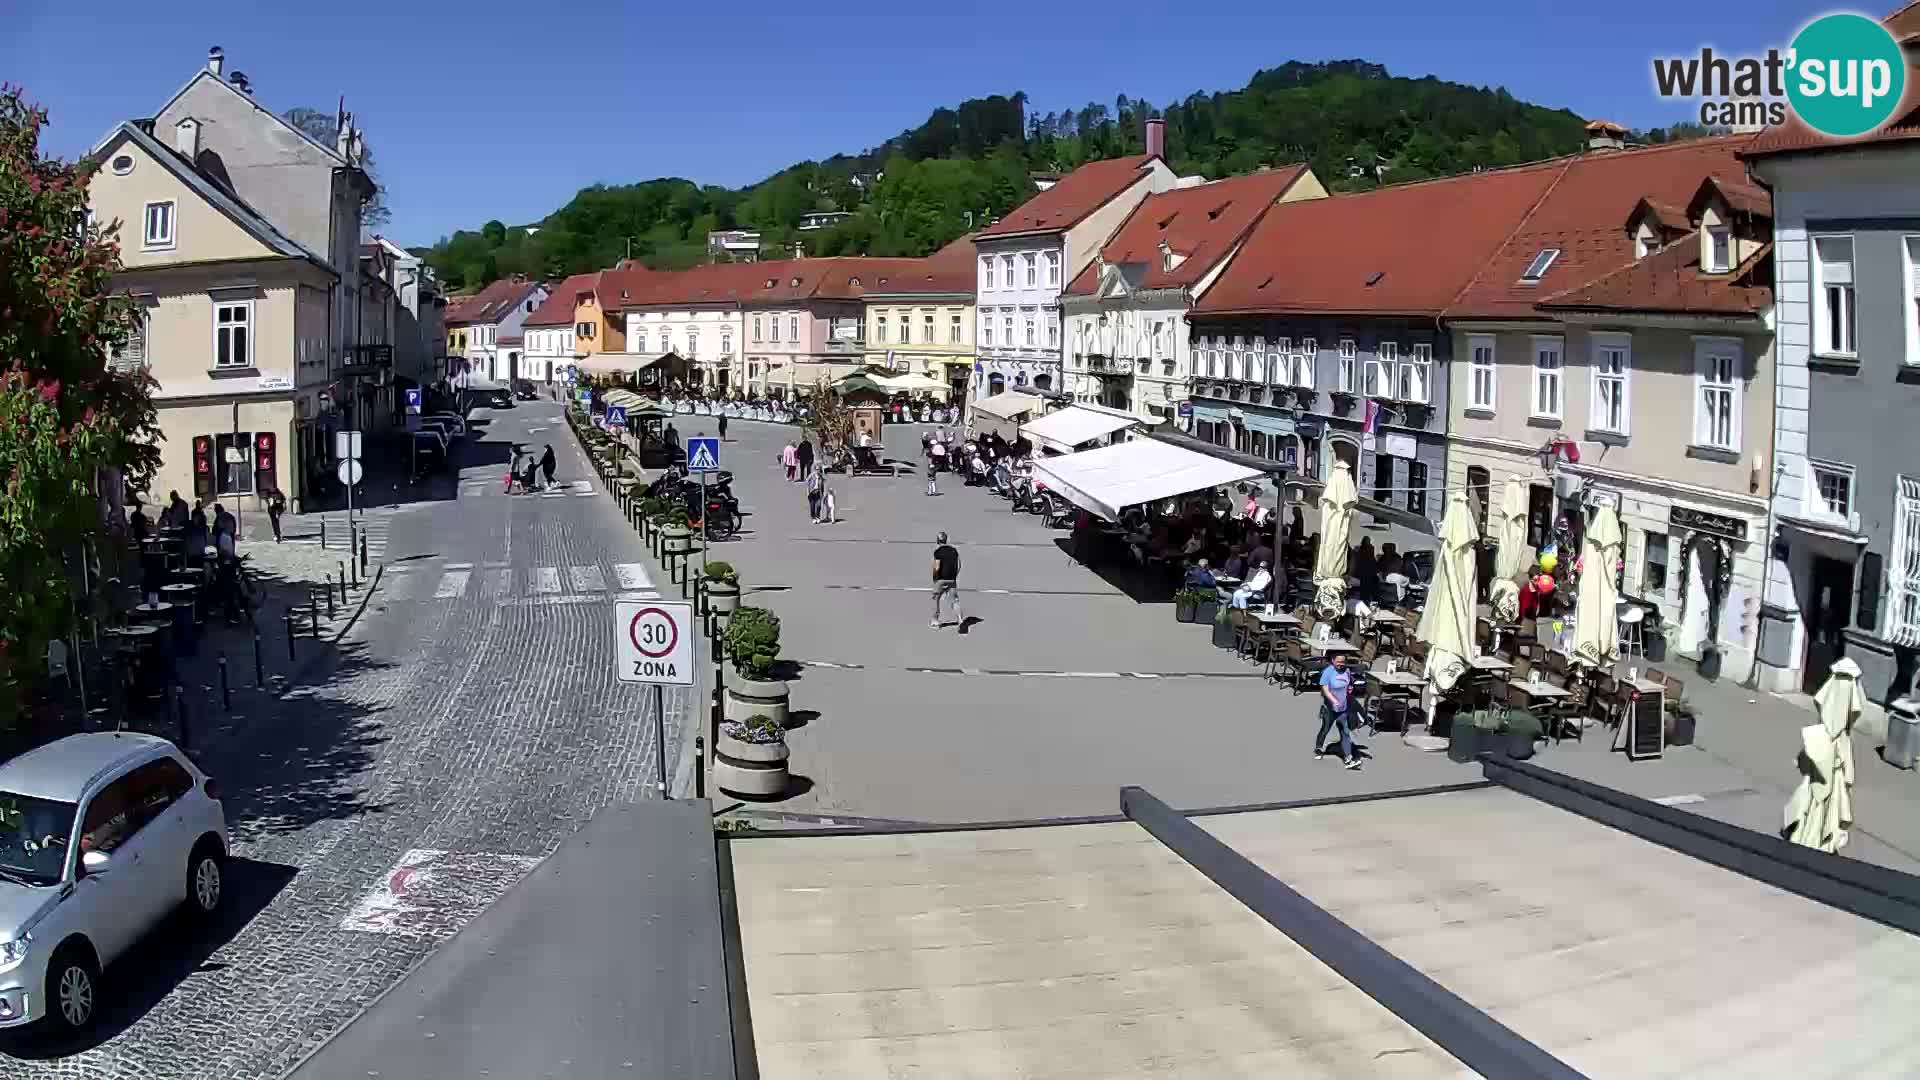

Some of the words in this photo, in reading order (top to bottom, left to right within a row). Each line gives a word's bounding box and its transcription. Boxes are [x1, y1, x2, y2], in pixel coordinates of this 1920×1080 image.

[409, 392, 417, 403] P
[642, 623, 666, 644] 30
[633, 660, 676, 677] ZONA
